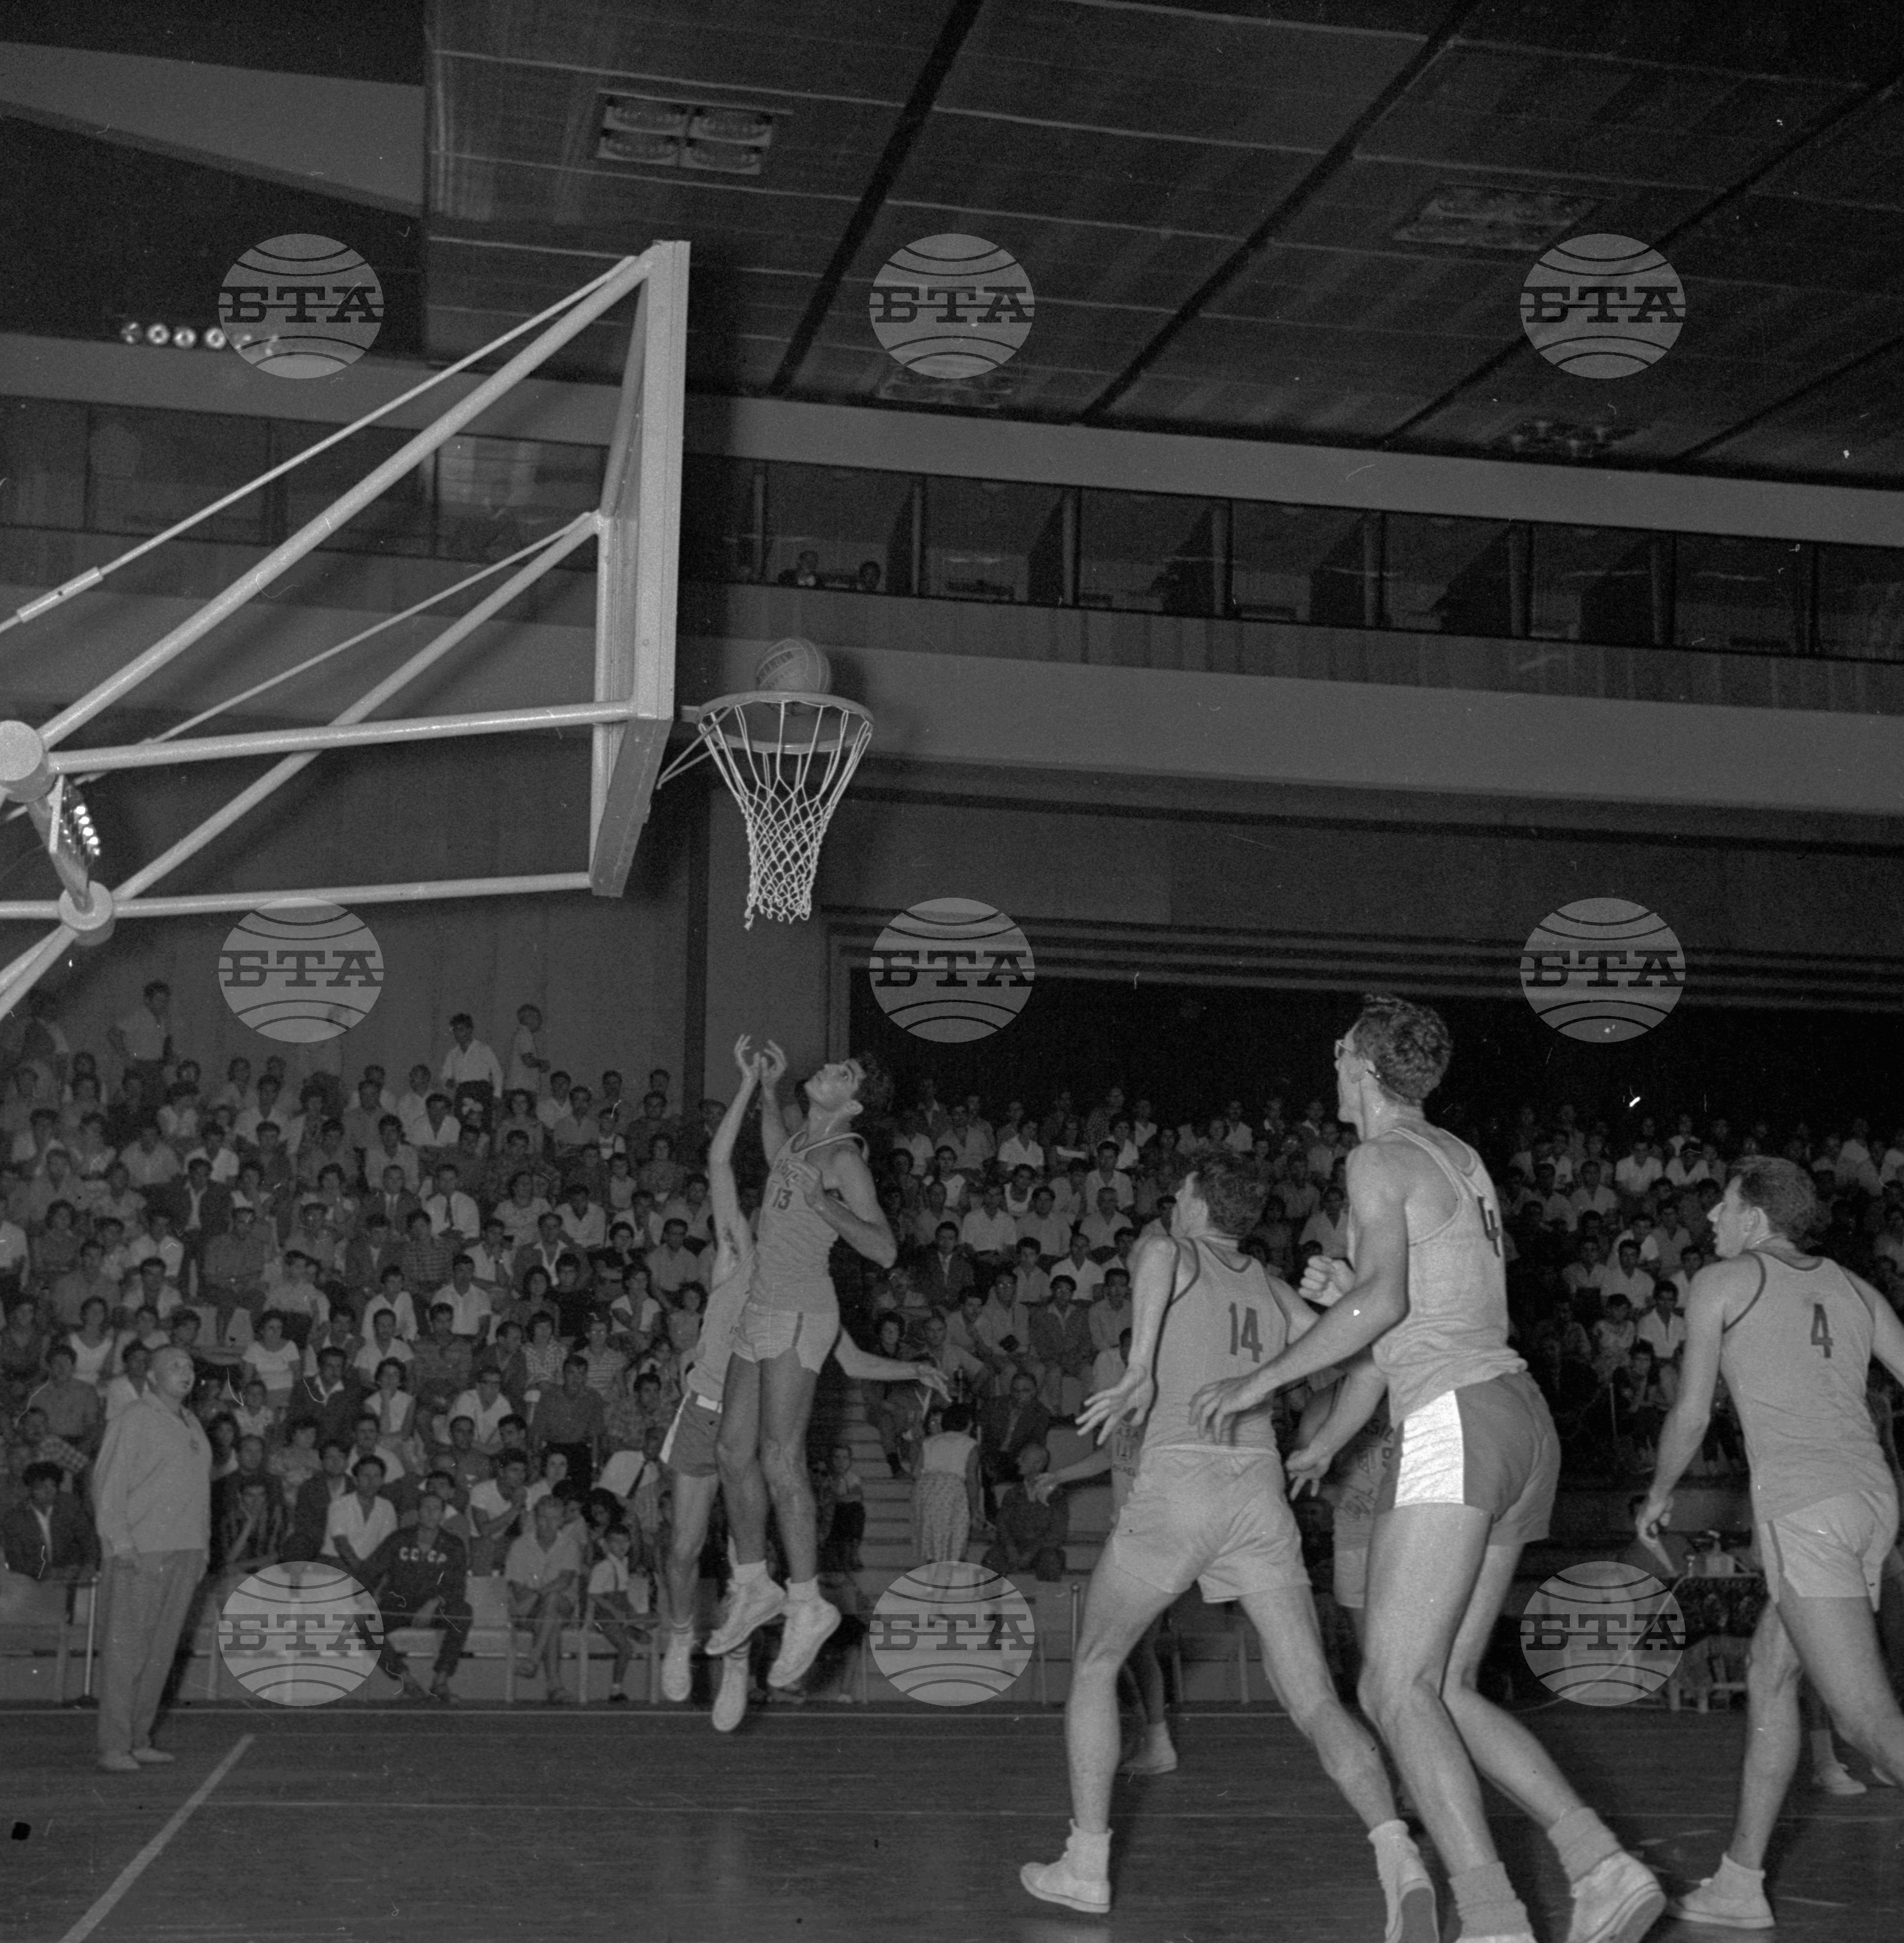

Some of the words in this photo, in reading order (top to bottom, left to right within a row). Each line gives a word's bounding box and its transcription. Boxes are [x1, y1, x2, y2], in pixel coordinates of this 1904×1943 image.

[772, 1187, 793, 1211] 13
[1228, 1302, 1263, 1363] 14
[1810, 1303, 1834, 1358] 4
[399, 1546, 447, 1566] СССР
